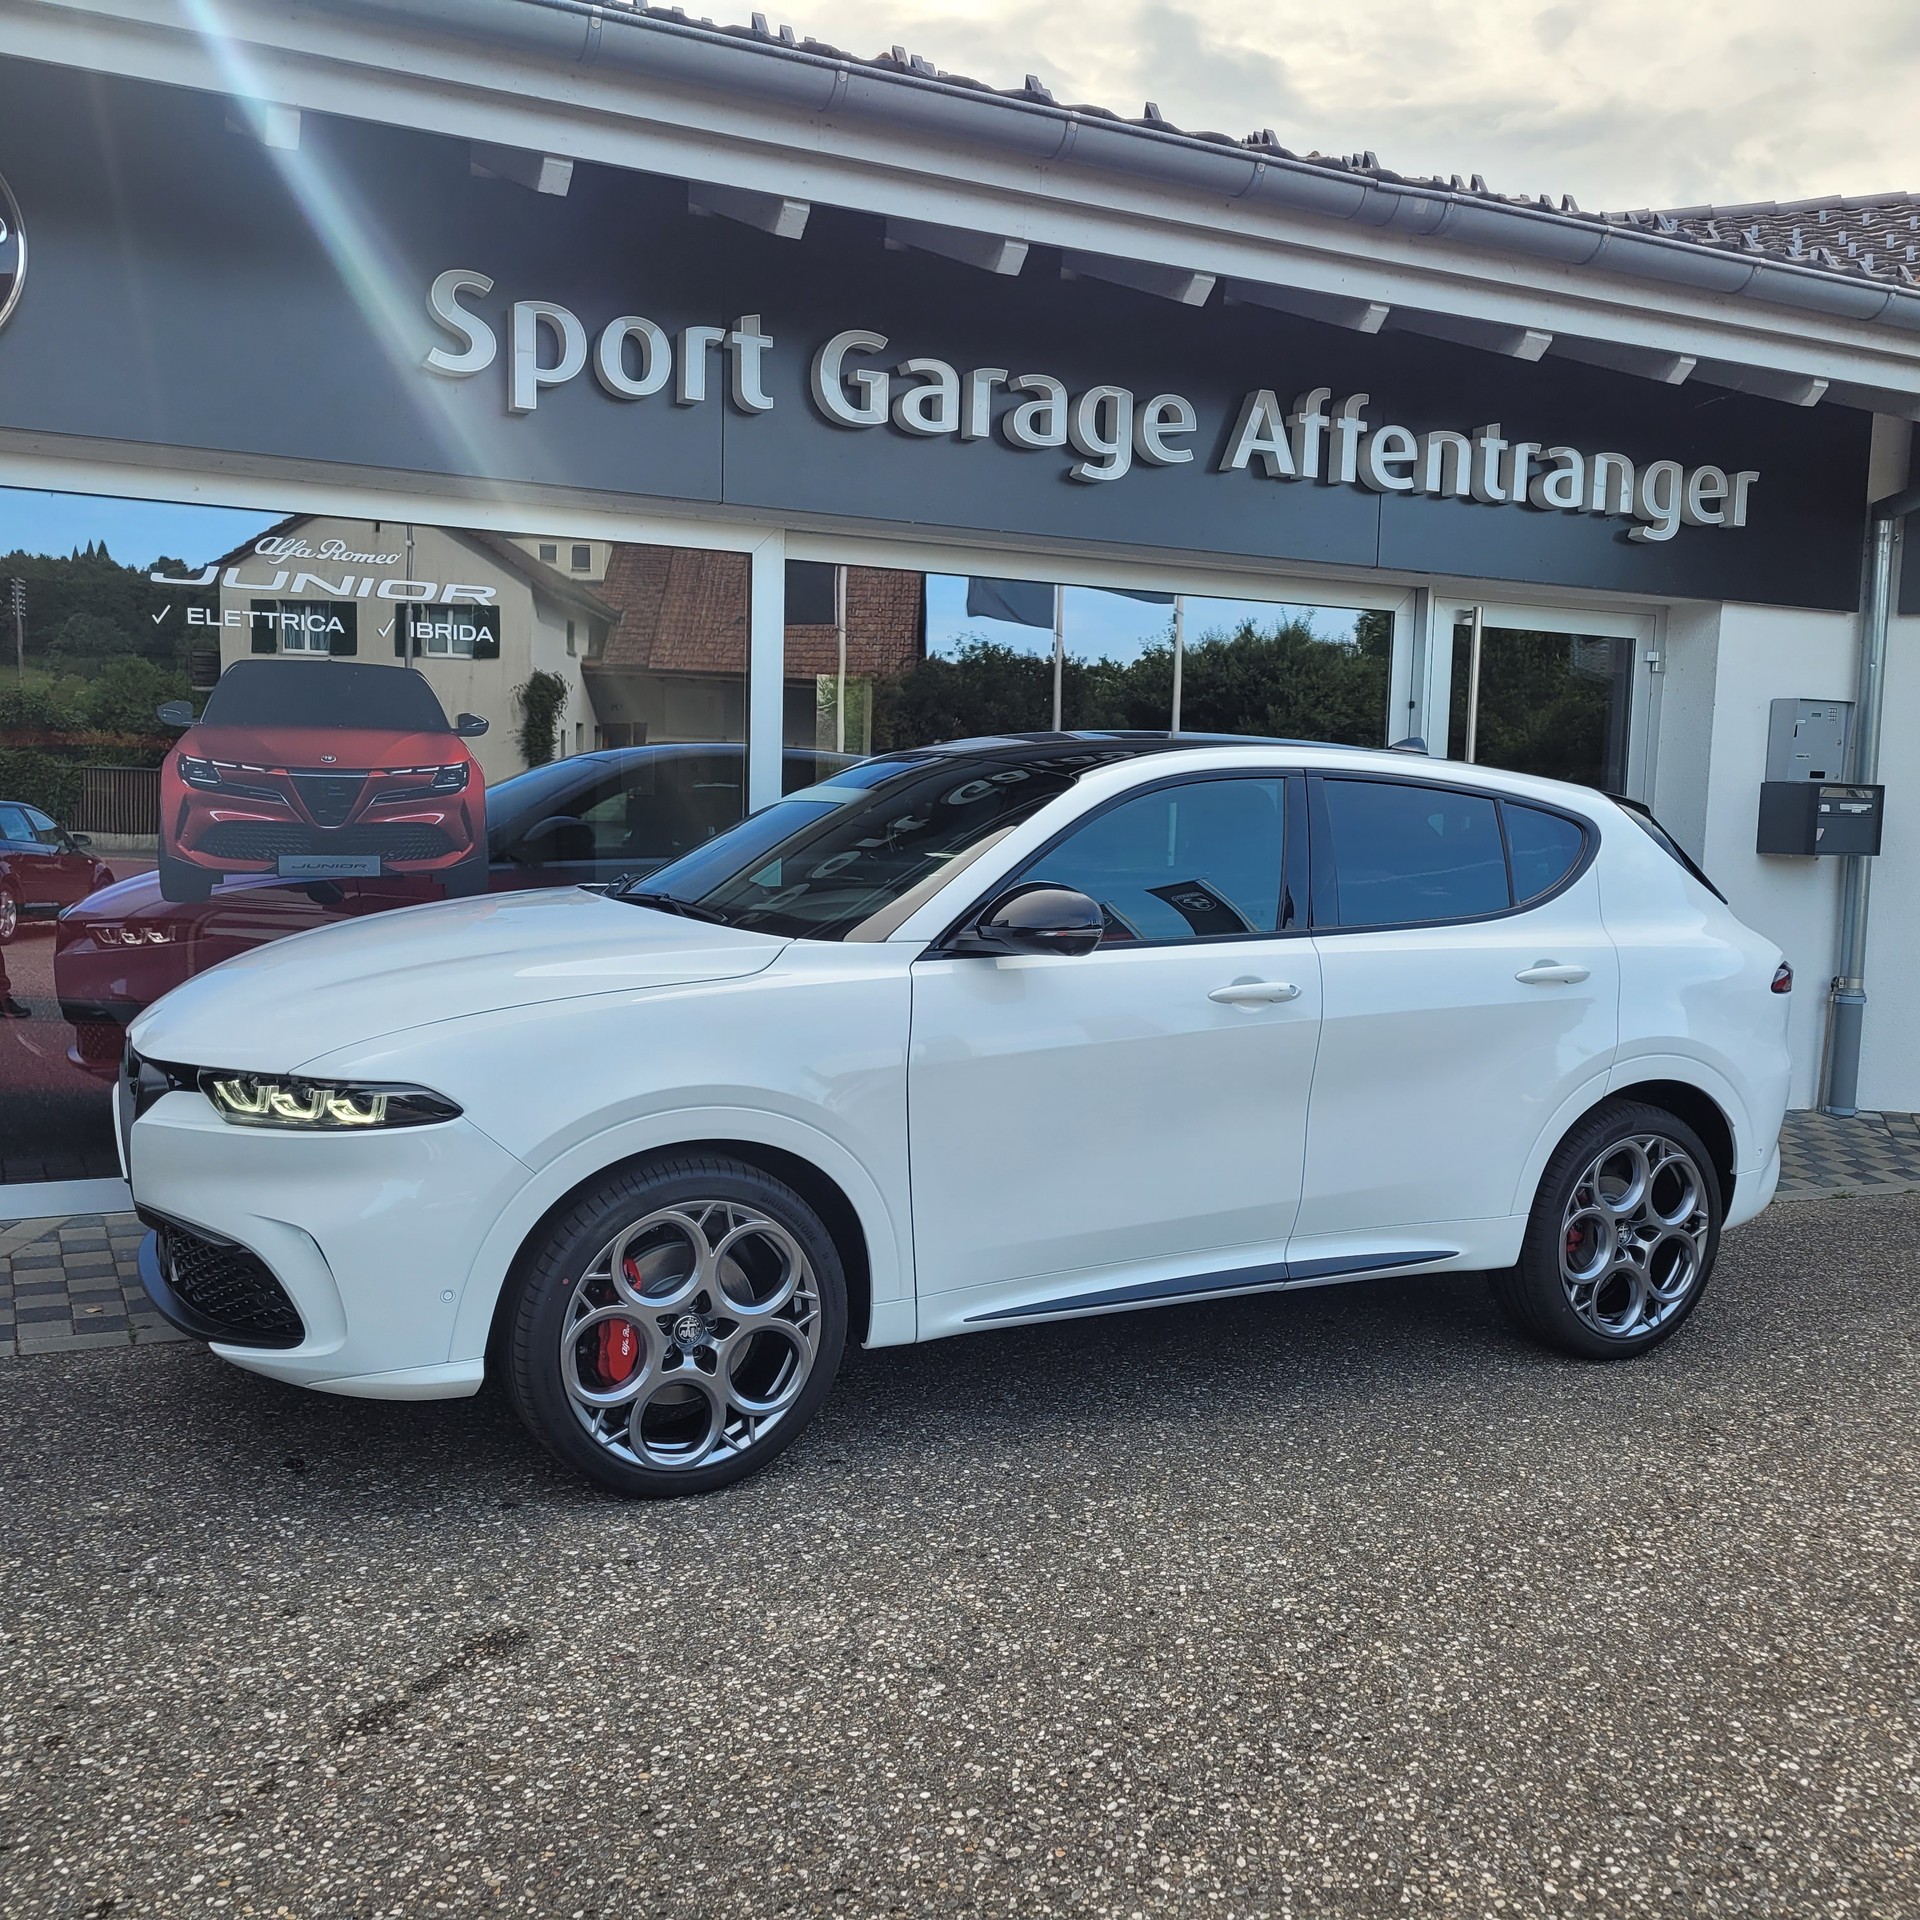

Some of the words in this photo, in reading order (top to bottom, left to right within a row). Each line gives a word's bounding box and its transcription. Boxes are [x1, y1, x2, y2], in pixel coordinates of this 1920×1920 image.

[421, 268, 774, 414] Sport
[811, 329, 1197, 484] Garage
[1219, 387, 1760, 543] Affentranger
[255, 536, 321, 565] Alfa
[318, 539, 402, 565] Romeo
[150, 565, 497, 606] JUNIOR
[187, 607, 346, 634] ELETTRICA
[410, 621, 495, 642] IBRIDA
